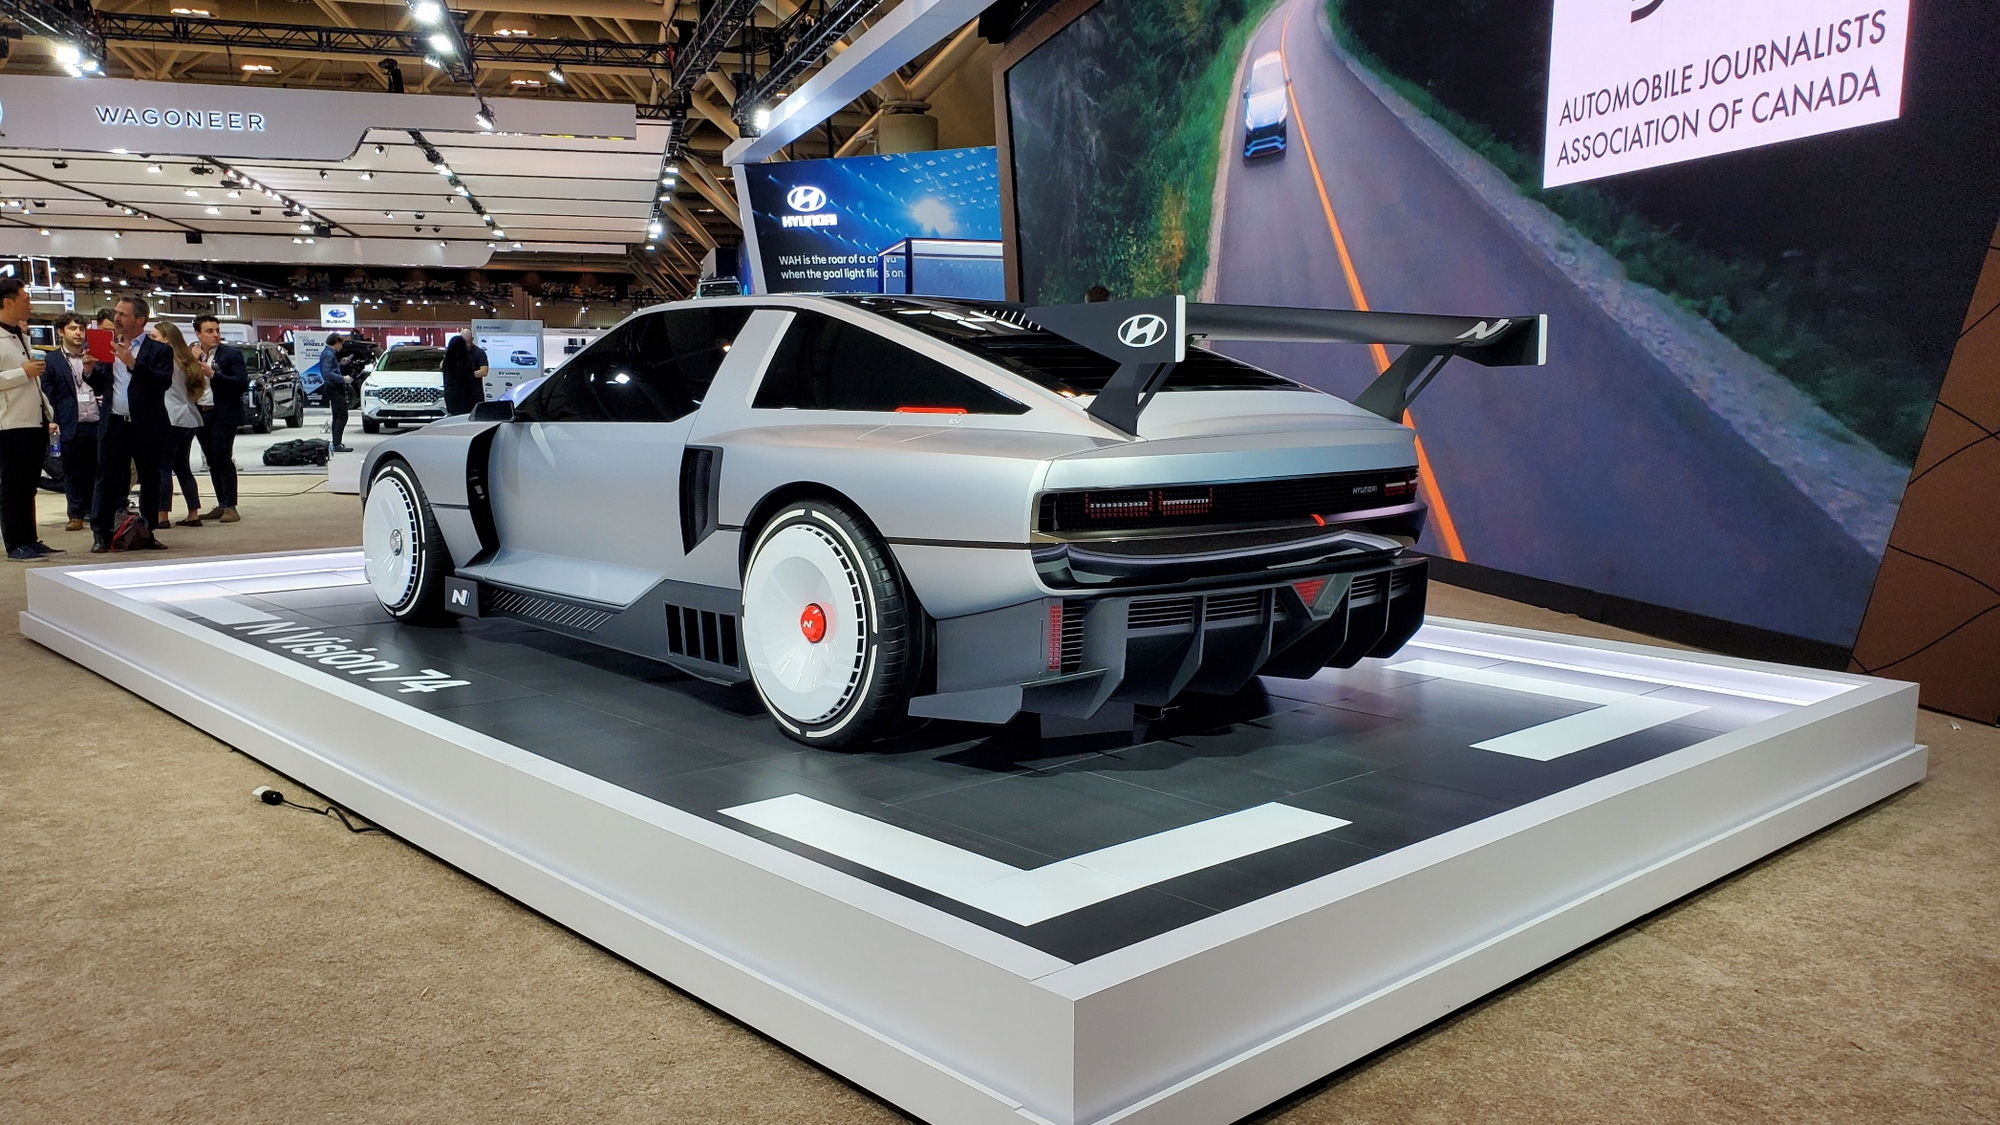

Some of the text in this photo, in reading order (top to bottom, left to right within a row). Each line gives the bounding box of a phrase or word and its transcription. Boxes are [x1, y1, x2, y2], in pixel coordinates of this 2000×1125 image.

[1558, 9, 1886, 127] AUTOMOBILE JOURNALISTS
[94, 106, 264, 130] WAGONEER
[1556, 65, 1881, 167] ASSOCIATION OF CANADA
[781, 213, 838, 228] HYUNDAI
[779, 255, 801, 265] WAH
[803, 254, 811, 265] is
[811, 254, 827, 265] the
[828, 255, 847, 264] roar
[848, 254, 858, 264] of
[859, 255, 866, 263] a
[781, 269, 806, 279] when
[806, 269, 822, 279] the
[823, 268, 843, 280] goal
[844, 268, 865, 280] light
[866, 268, 890, 278] flics
[1352, 485, 1378, 495] HYUNDAI
[451, 588, 470, 607] N
[803, 619, 814, 629] N
[233, 621, 472, 693] N Vision 74
